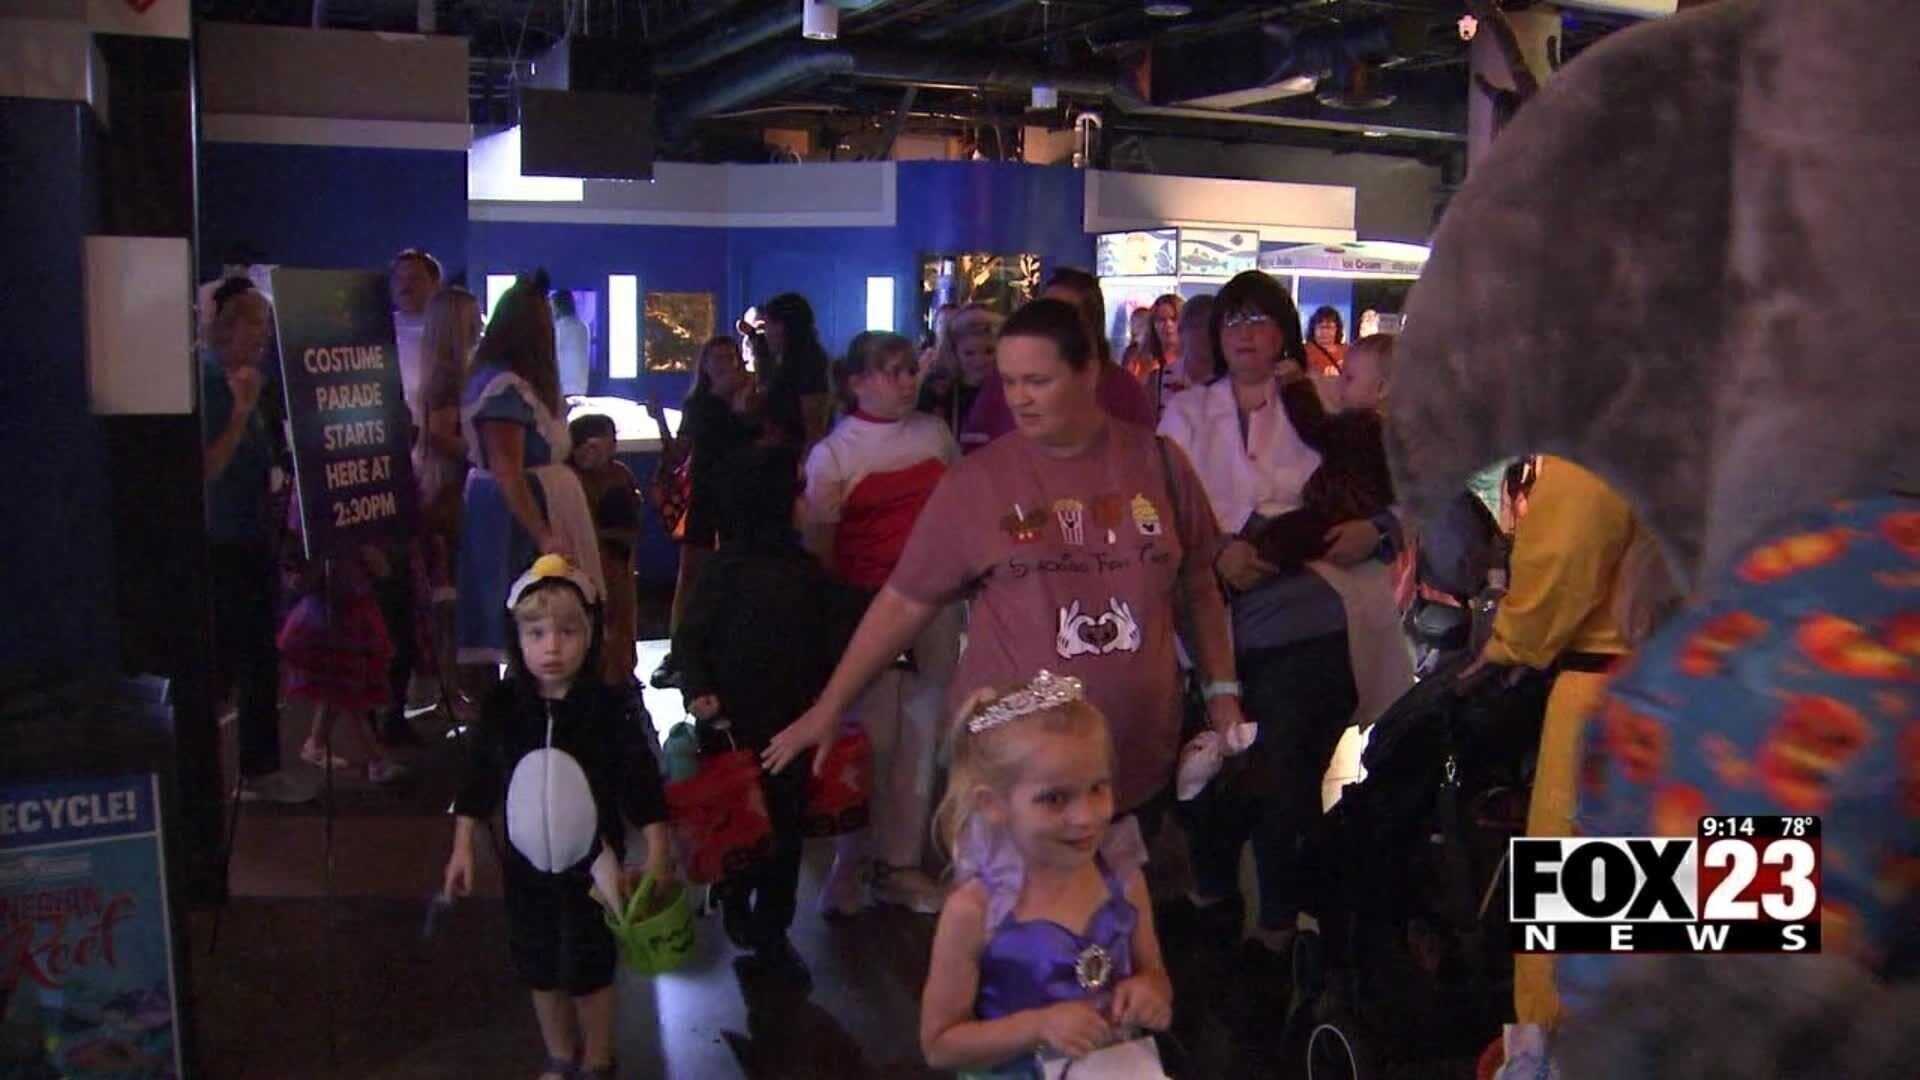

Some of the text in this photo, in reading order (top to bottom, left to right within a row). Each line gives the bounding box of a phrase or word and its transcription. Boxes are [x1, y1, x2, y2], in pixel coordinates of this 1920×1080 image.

[1355, 258, 1382, 270] Cream
[304, 346, 384, 373] COSTUME
[316, 383, 383, 412] PARADE
[323, 420, 385, 450] STARTS
[326, 455, 392, 489] HERE AT
[333, 492, 396, 526] 2:30PM
